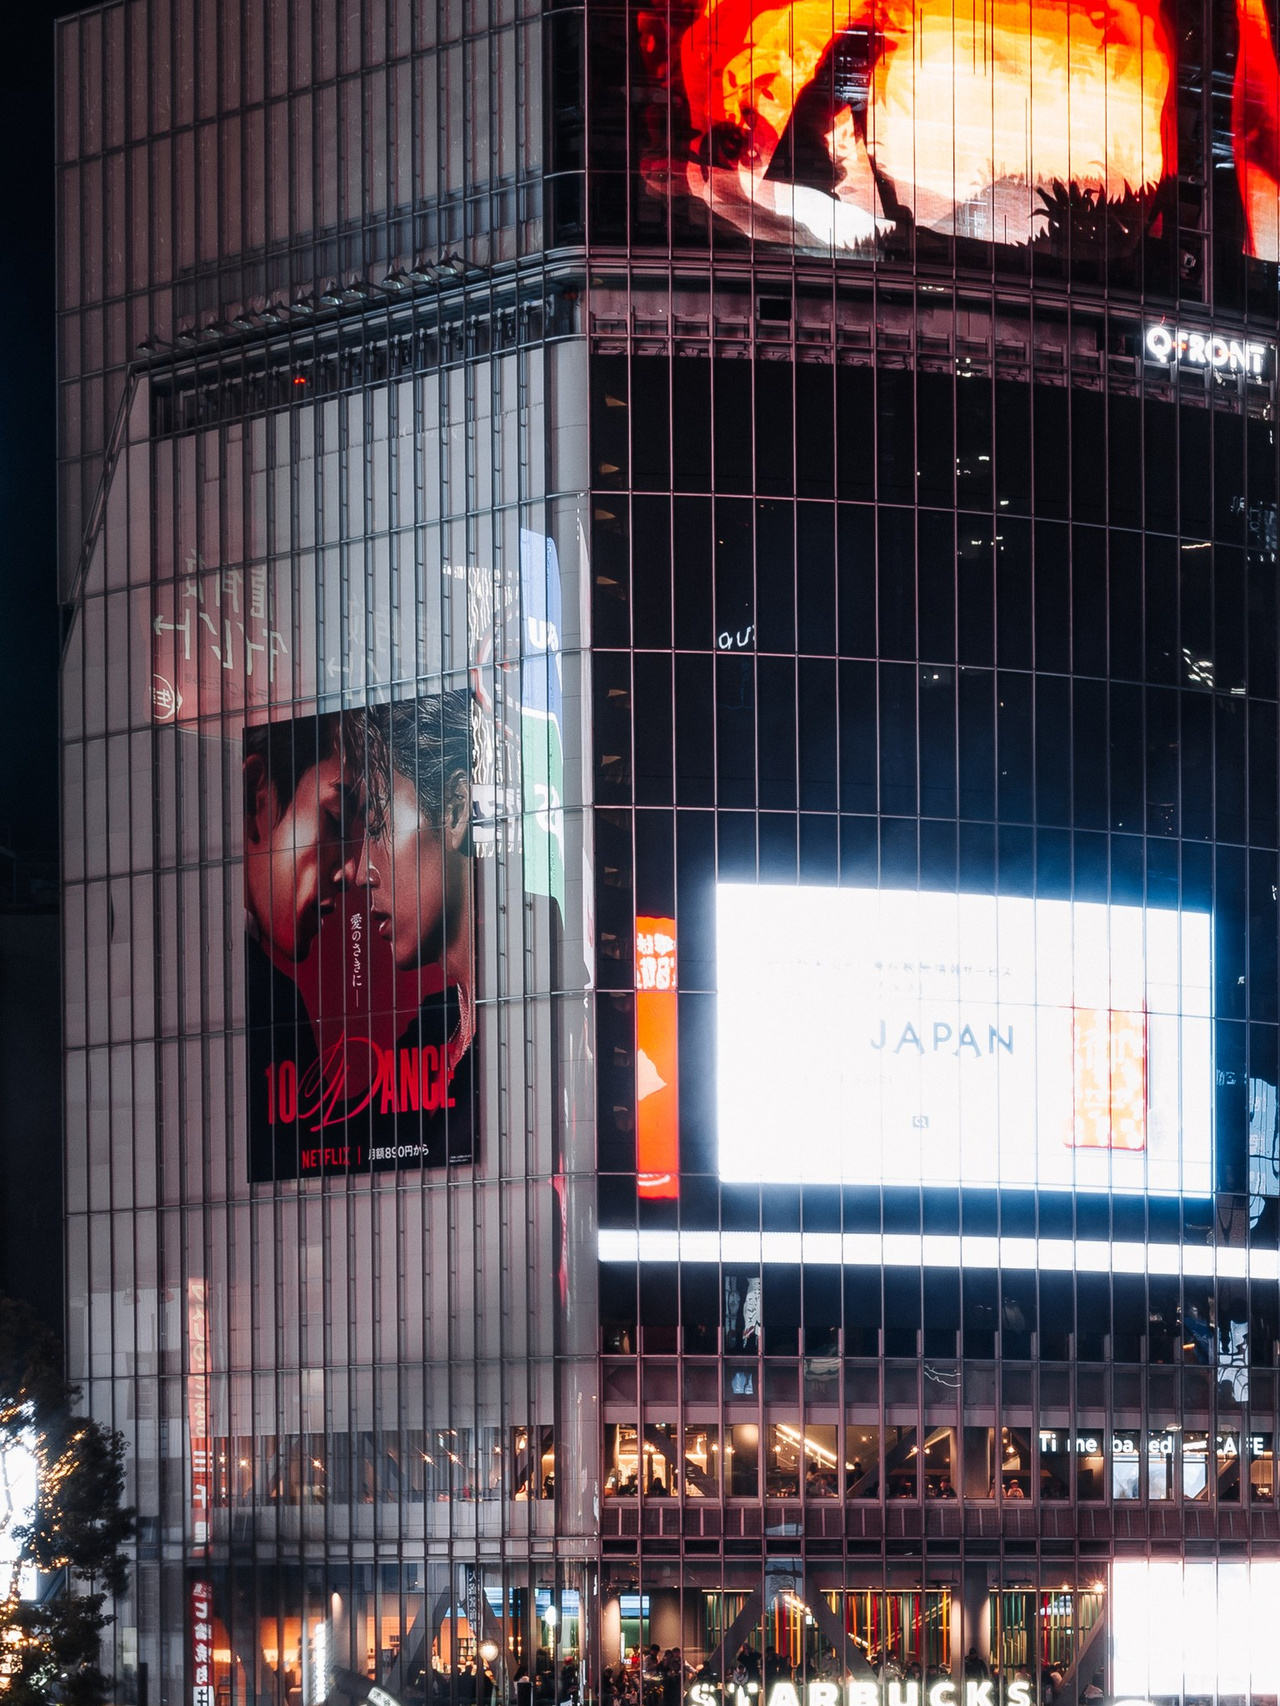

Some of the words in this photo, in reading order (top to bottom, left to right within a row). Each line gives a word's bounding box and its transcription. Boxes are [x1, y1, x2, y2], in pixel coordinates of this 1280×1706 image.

[870, 1019, 1015, 1059] JAPAN
[265, 1060, 297, 1126] 10
[301, 1146, 351, 1170] NETFLIX
[368, 1143, 430, 1161] 月額890円から
[1112, 1436, 1174, 1454] baed
